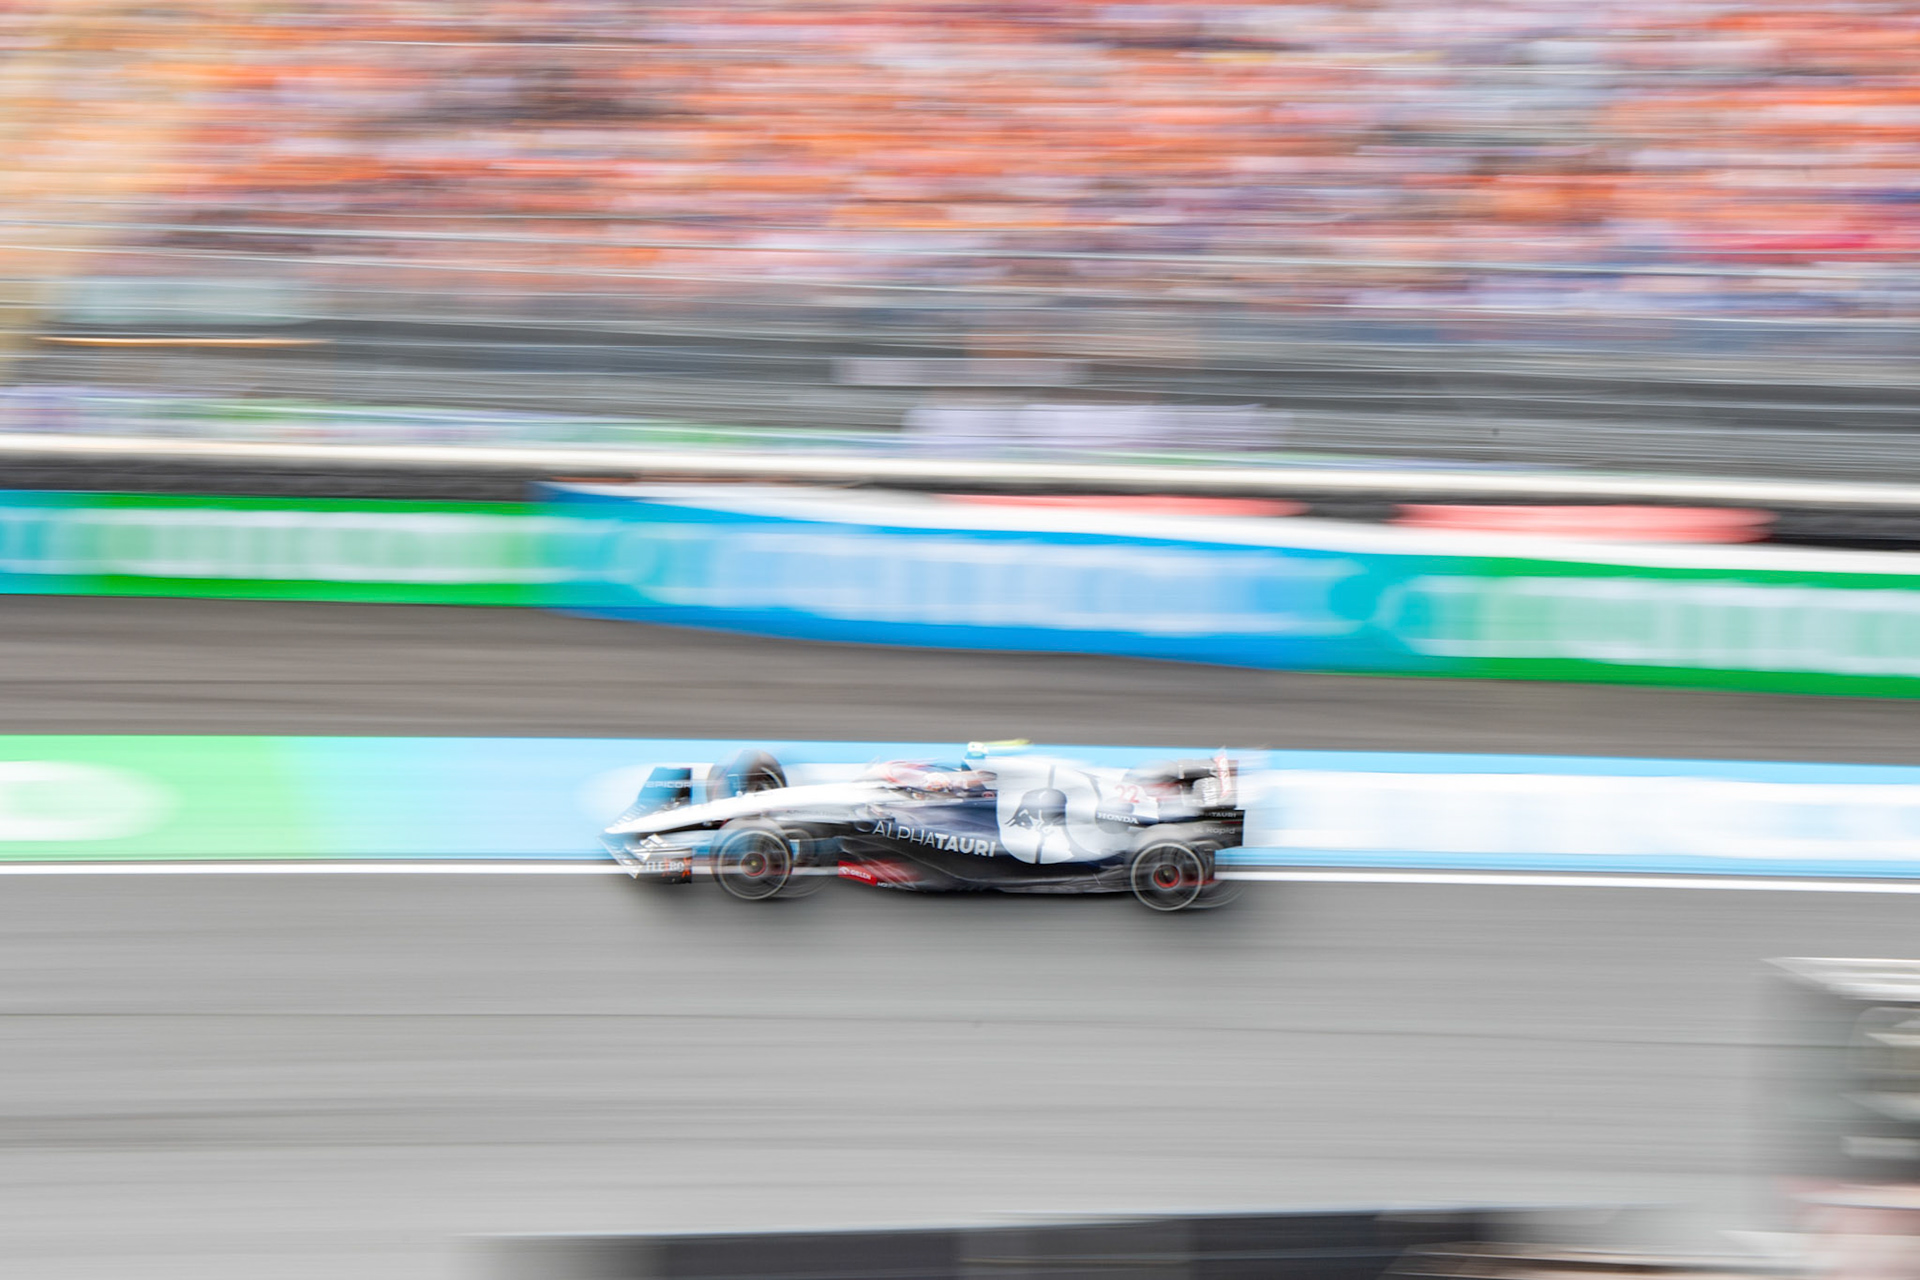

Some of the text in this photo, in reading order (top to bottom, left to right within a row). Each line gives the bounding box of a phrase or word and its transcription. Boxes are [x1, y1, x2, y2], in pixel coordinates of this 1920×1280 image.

[1114, 784, 1139, 803] 22
[1097, 812, 1140, 825] HONDA
[872, 820, 997, 857] ALPHATAURI
